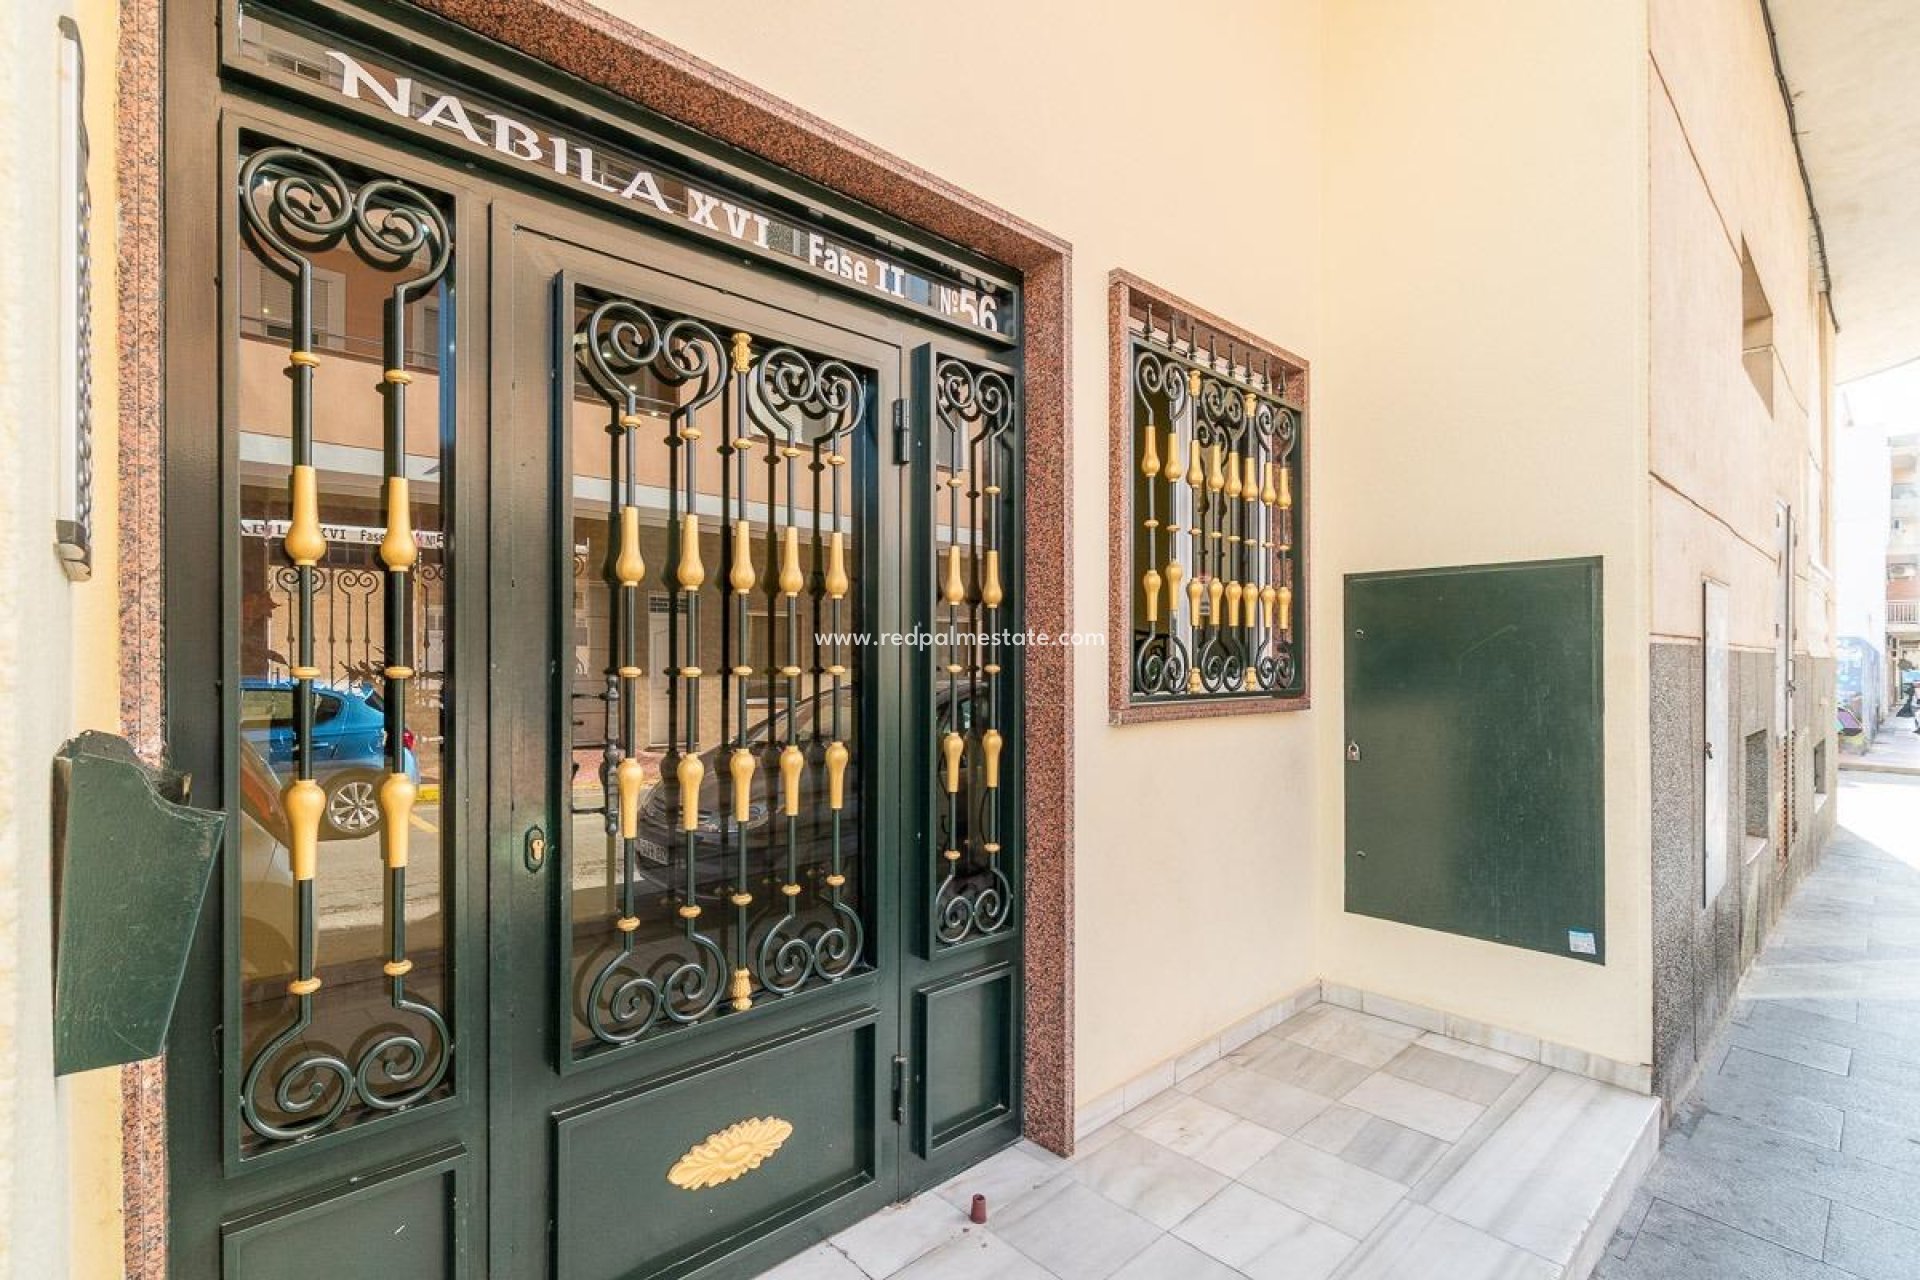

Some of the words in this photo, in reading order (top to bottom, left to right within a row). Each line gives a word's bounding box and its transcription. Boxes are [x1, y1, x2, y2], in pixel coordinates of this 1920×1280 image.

[325, 50, 674, 214] NABILA
[687, 188, 770, 250] XVI
[809, 232, 868, 286] Fase
